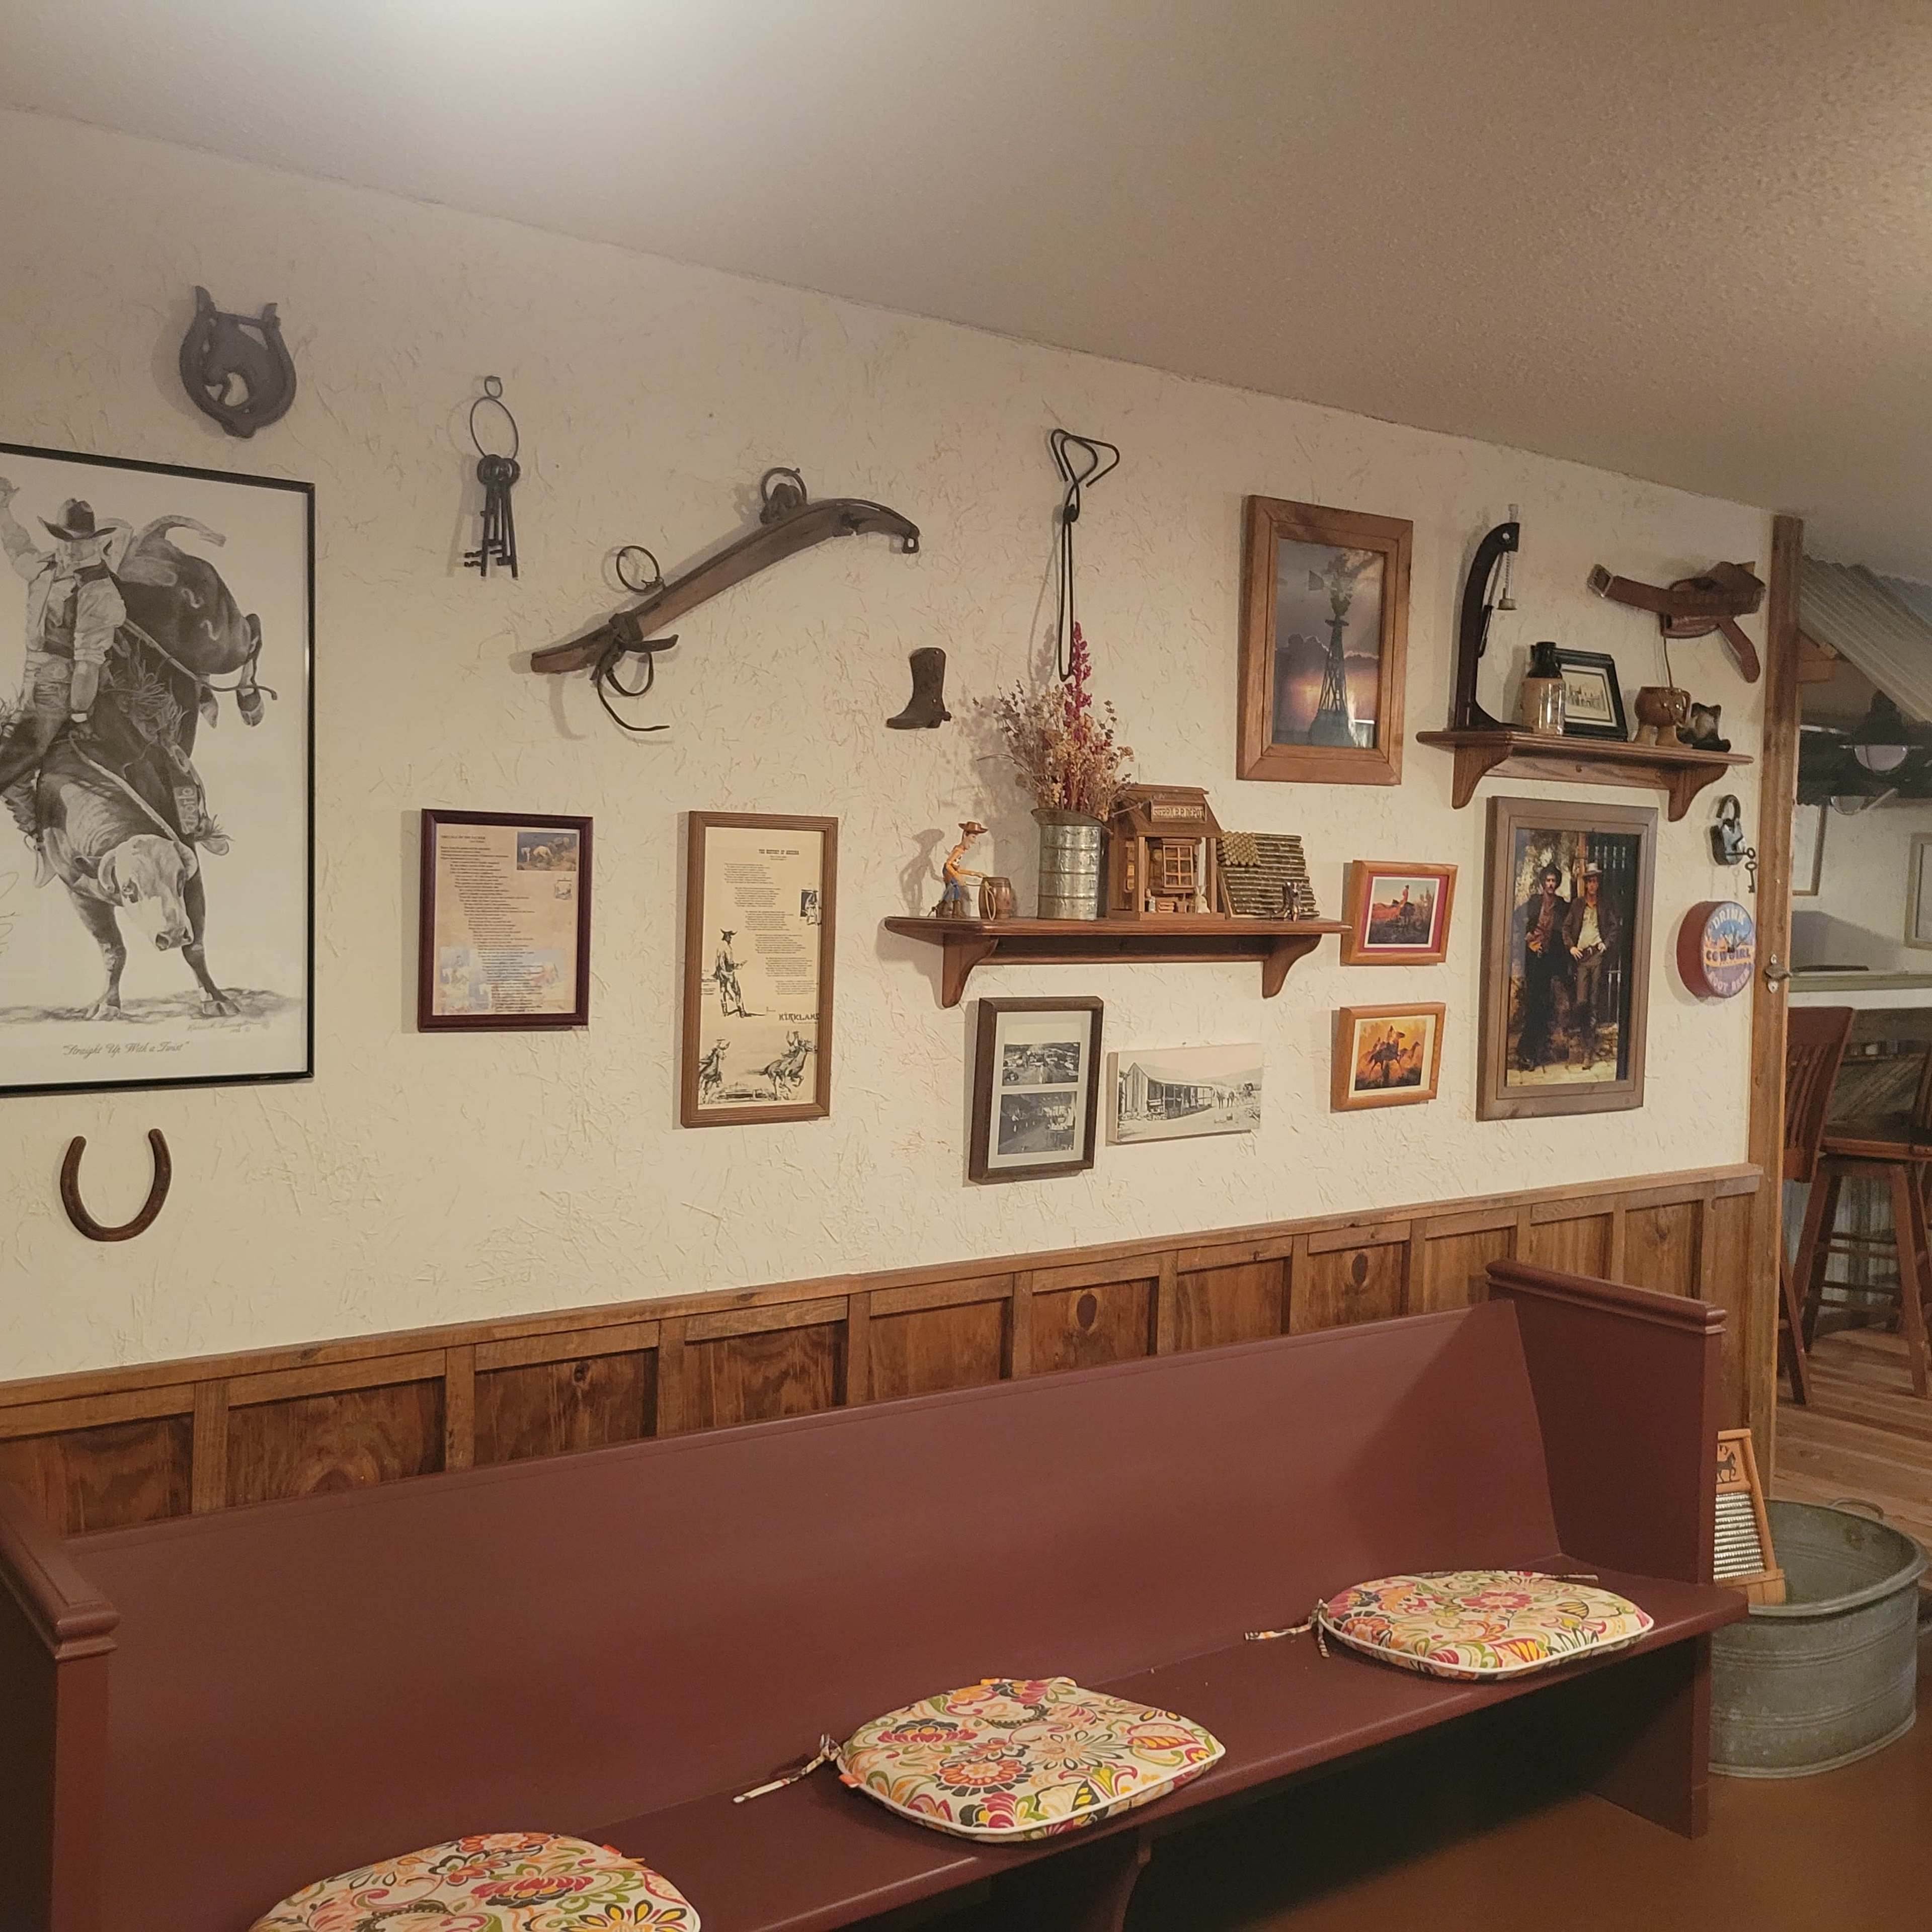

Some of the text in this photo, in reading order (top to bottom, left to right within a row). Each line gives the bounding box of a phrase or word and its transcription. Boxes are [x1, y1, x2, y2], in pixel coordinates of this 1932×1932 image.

[1712, 908, 1745, 929] DRINK
[1706, 948, 1751, 961] COWGIRL
[1709, 971, 1729, 993] ROOT
[105, 1043, 120, 1058] Up
[124, 1042, 149, 1054] With
